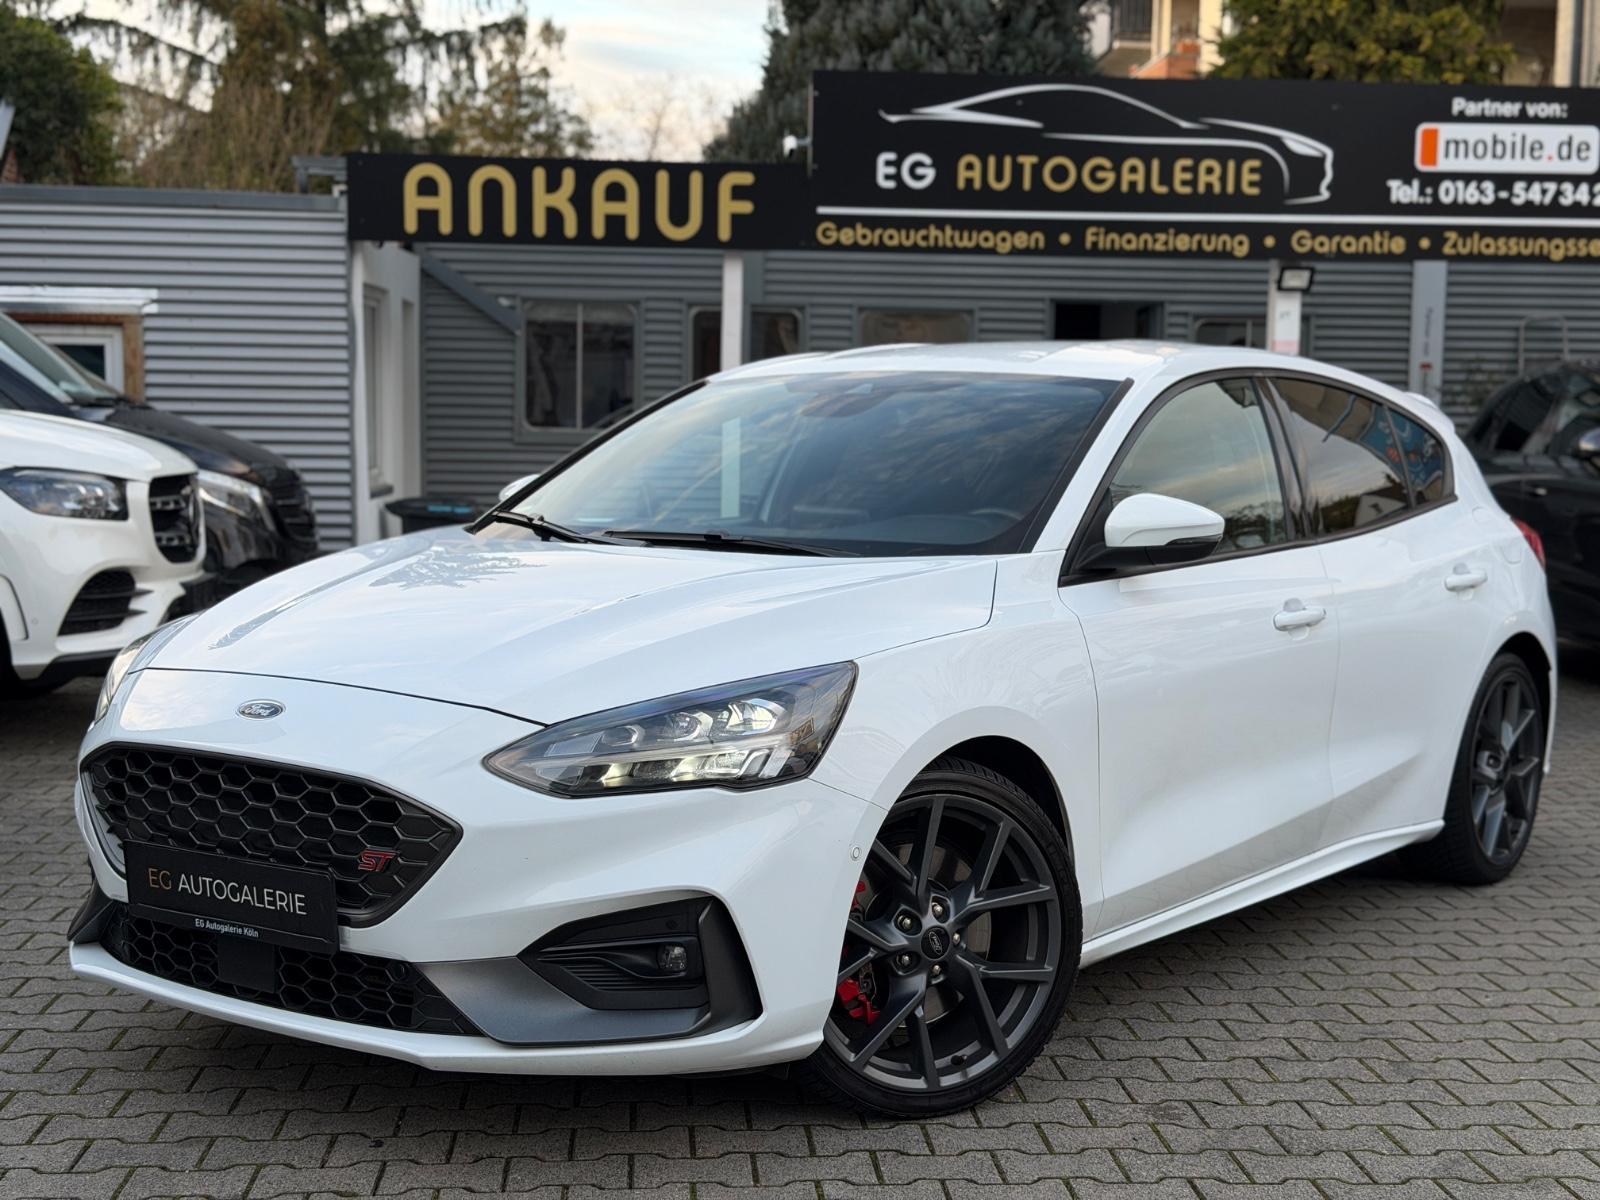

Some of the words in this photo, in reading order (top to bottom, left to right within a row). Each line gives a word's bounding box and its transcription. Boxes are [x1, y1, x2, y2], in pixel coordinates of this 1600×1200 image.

[1451, 96, 1523, 118] Partner
[1525, 102, 1569, 119] von:
[1443, 133, 1591, 161] mobile.de
[875, 151, 937, 190] EG
[956, 153, 1262, 196] AUTOGALERIE
[402, 162, 756, 243] ANKAUF
[1386, 178, 1433, 204] Tel.:
[815, 220, 1046, 254] Gebrauchtwagen
[1084, 226, 1250, 258] Finanzierung
[1290, 229, 1407, 255] Garantie
[1442, 231, 1600, 262] Zulassungsse
[244, 703, 275, 717] Ford
[358, 850, 396, 872] ST
[148, 867, 172, 890] EG
[177, 873, 308, 916] AUTOGALERIE
[195, 918, 205, 928] EG
[205, 920, 243, 935] Autogalerie
[243, 926, 259, 938] Köln
